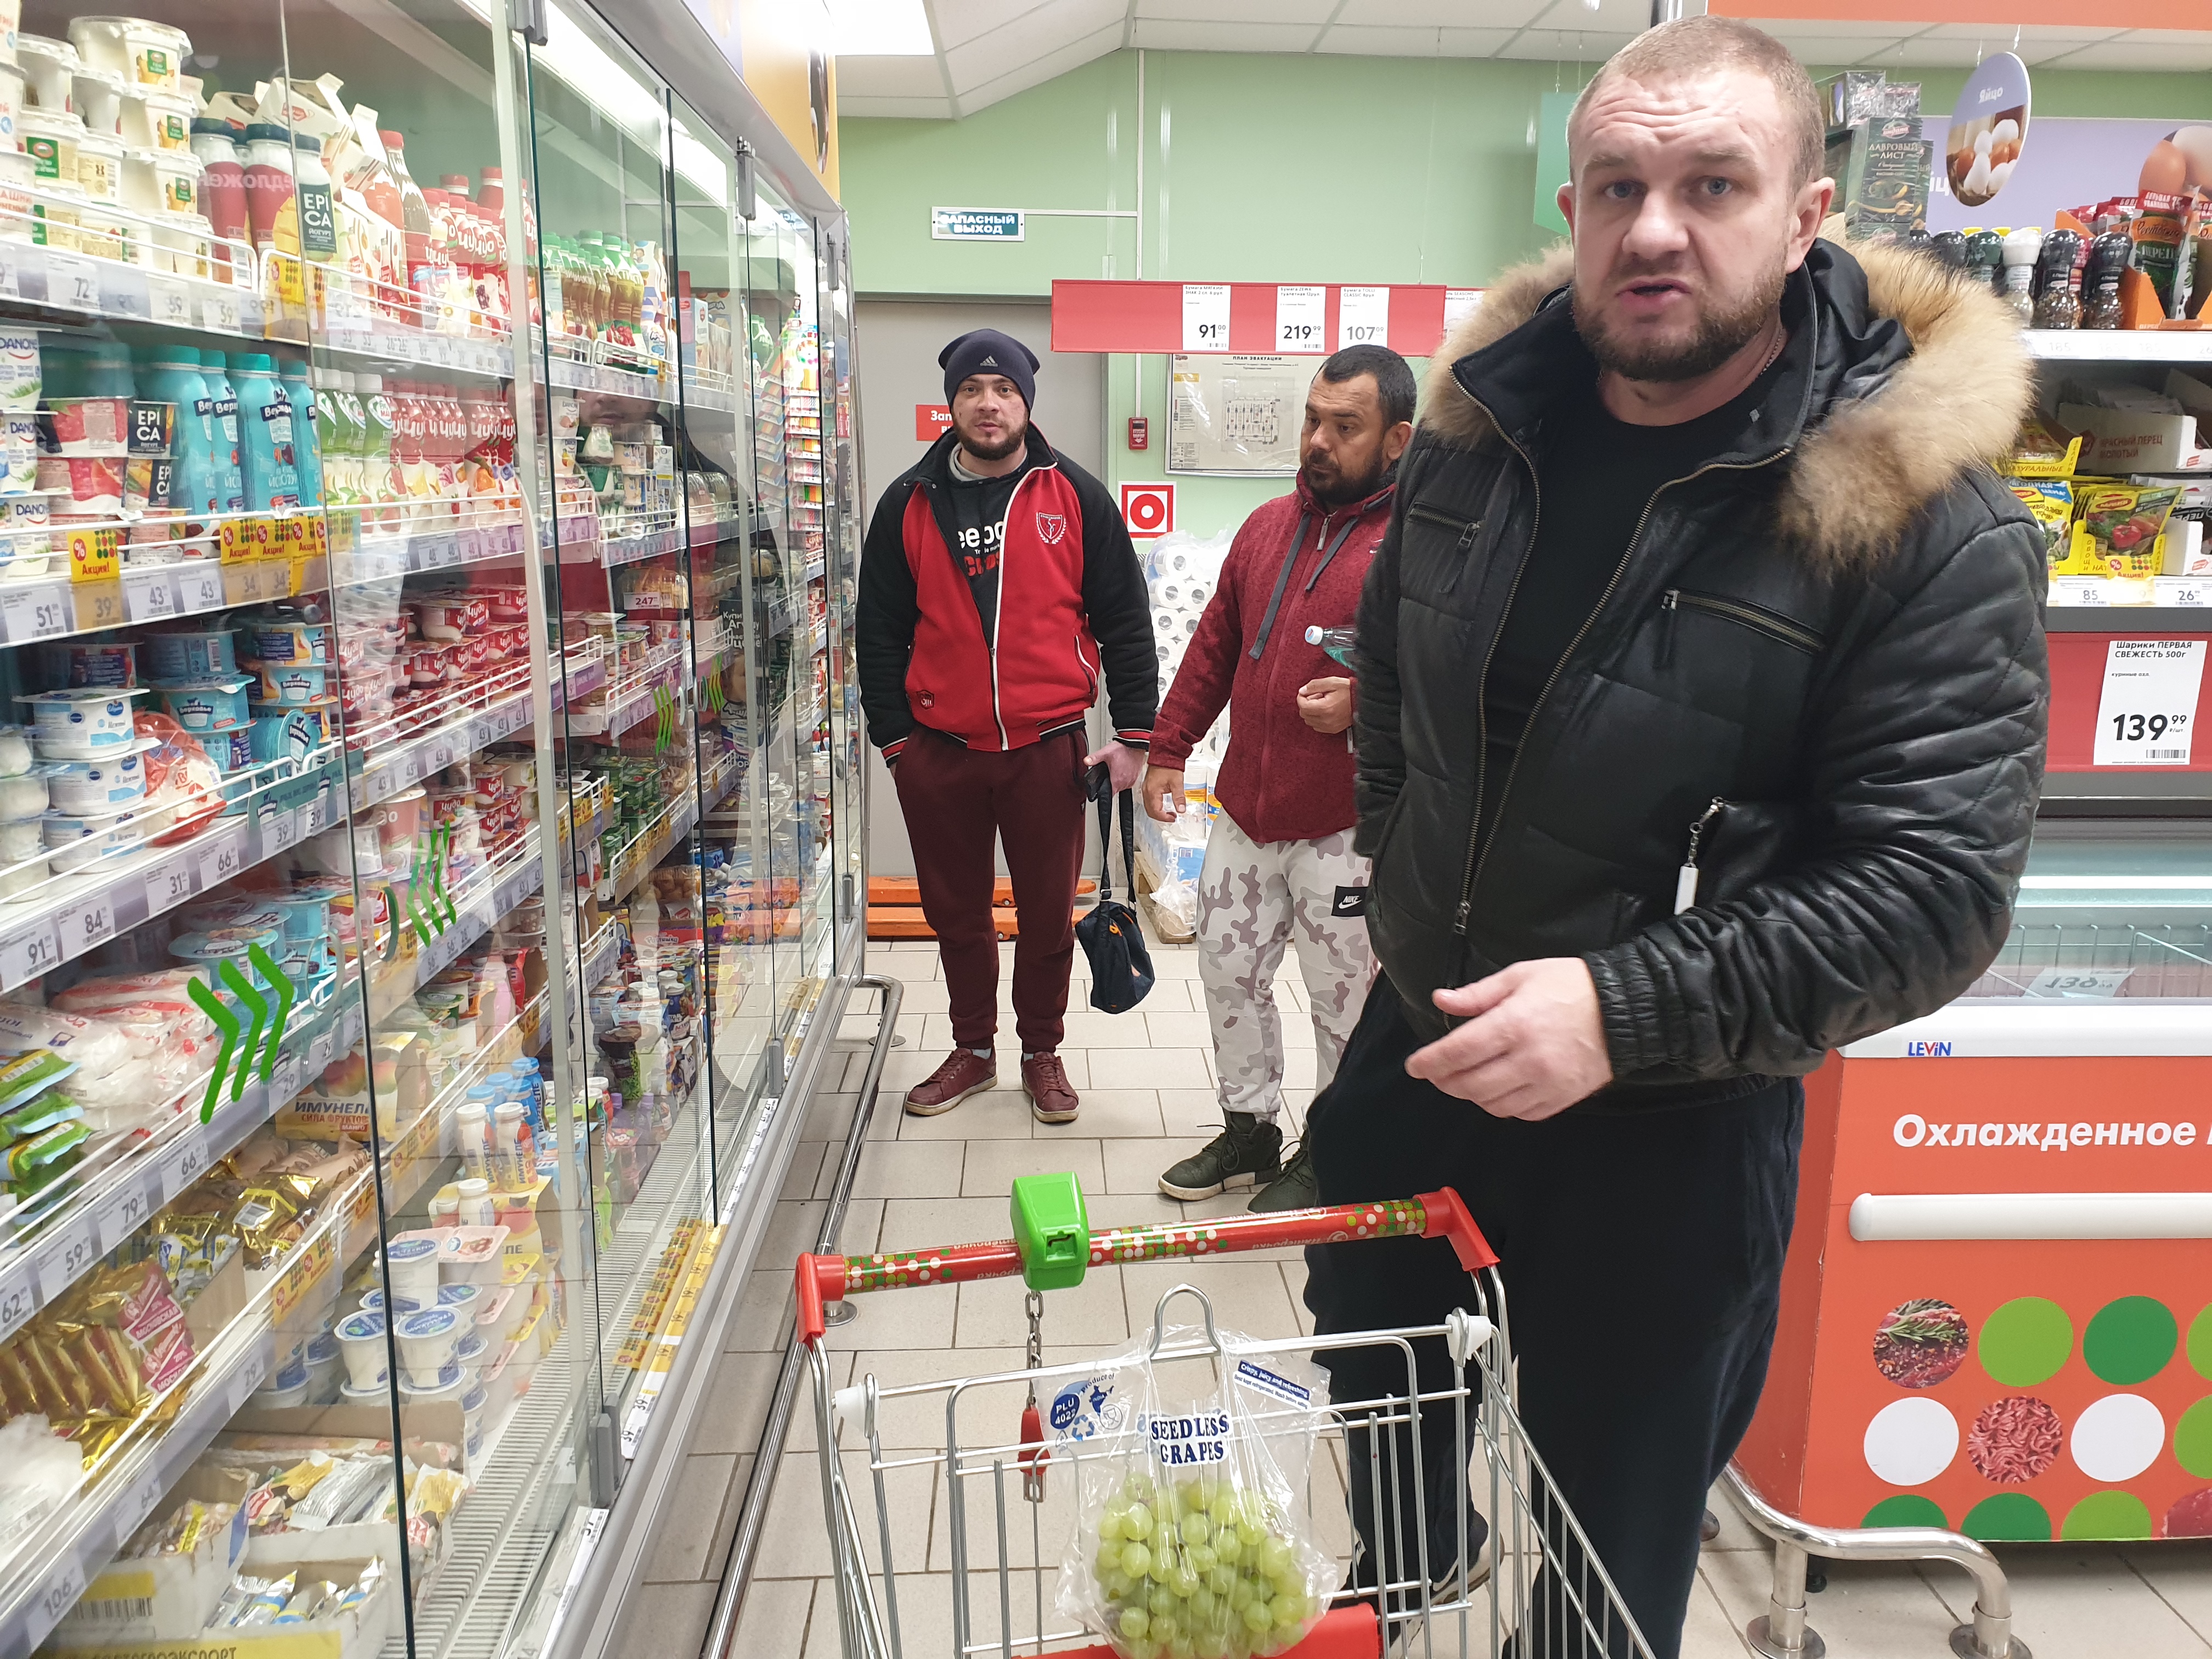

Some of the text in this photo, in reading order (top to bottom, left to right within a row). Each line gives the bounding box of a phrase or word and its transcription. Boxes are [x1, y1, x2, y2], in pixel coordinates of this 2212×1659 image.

[1979, 87, 2004, 103] Яйцо
[1869, 142, 1918, 151] ЛАВРОВЫЙ
[303, 193, 330, 211] EPI
[304, 211, 332, 228] CA
[953, 224, 1003, 234] ВЫХОД
[75, 277, 89, 299] 72
[1199, 324, 1216, 338] 91
[1283, 325, 1312, 340] 219
[1346, 326, 1375, 340] 107
[2049, 342, 2071, 352] 185
[138, 410, 160, 426] EPI
[930, 410, 952, 421] Зап
[137, 426, 160, 441] CA
[2138, 435, 2163, 445] ПЕРЕЦ
[82, 562, 110, 575] Акция!
[149, 586, 164, 605] 43
[201, 582, 214, 599] 43
[2083, 590, 2098, 600] 85
[2178, 590, 2194, 600] 26
[96, 597, 110, 618] 39
[635, 596, 654, 606] 247
[37, 606, 53, 628] 51
[469, 603, 486, 618] Чудо
[2116, 641, 2155, 650] Шарики
[2113, 714, 2187, 741] 139 99
[311, 809, 321, 827] 39
[277, 824, 289, 843] 39
[217, 853, 232, 872] 66
[170, 875, 182, 895] 31
[84, 910, 103, 933] 84
[28, 938, 46, 964] 91
[302, 1114, 369, 1124] СИЛА ФРУКТОВ
[1893, 1114, 2196, 1152] Охлажденное
[180, 1155, 197, 1176] 66
[121, 1199, 138, 1224] 79
[65, 1247, 83, 1272] 59
[1, 1293, 23, 1320] 62
[1081, 1374, 1107, 1393] Produce
[1234, 1374, 1243, 1382] Best
[1272, 1376, 1283, 1386] and
[1282, 1381, 1308, 1398] refreshing
[1056, 1397, 1074, 1414] PLU
[1150, 1413, 1230, 1440] SEEDLESS
[1160, 1440, 1225, 1465] GRAPES
